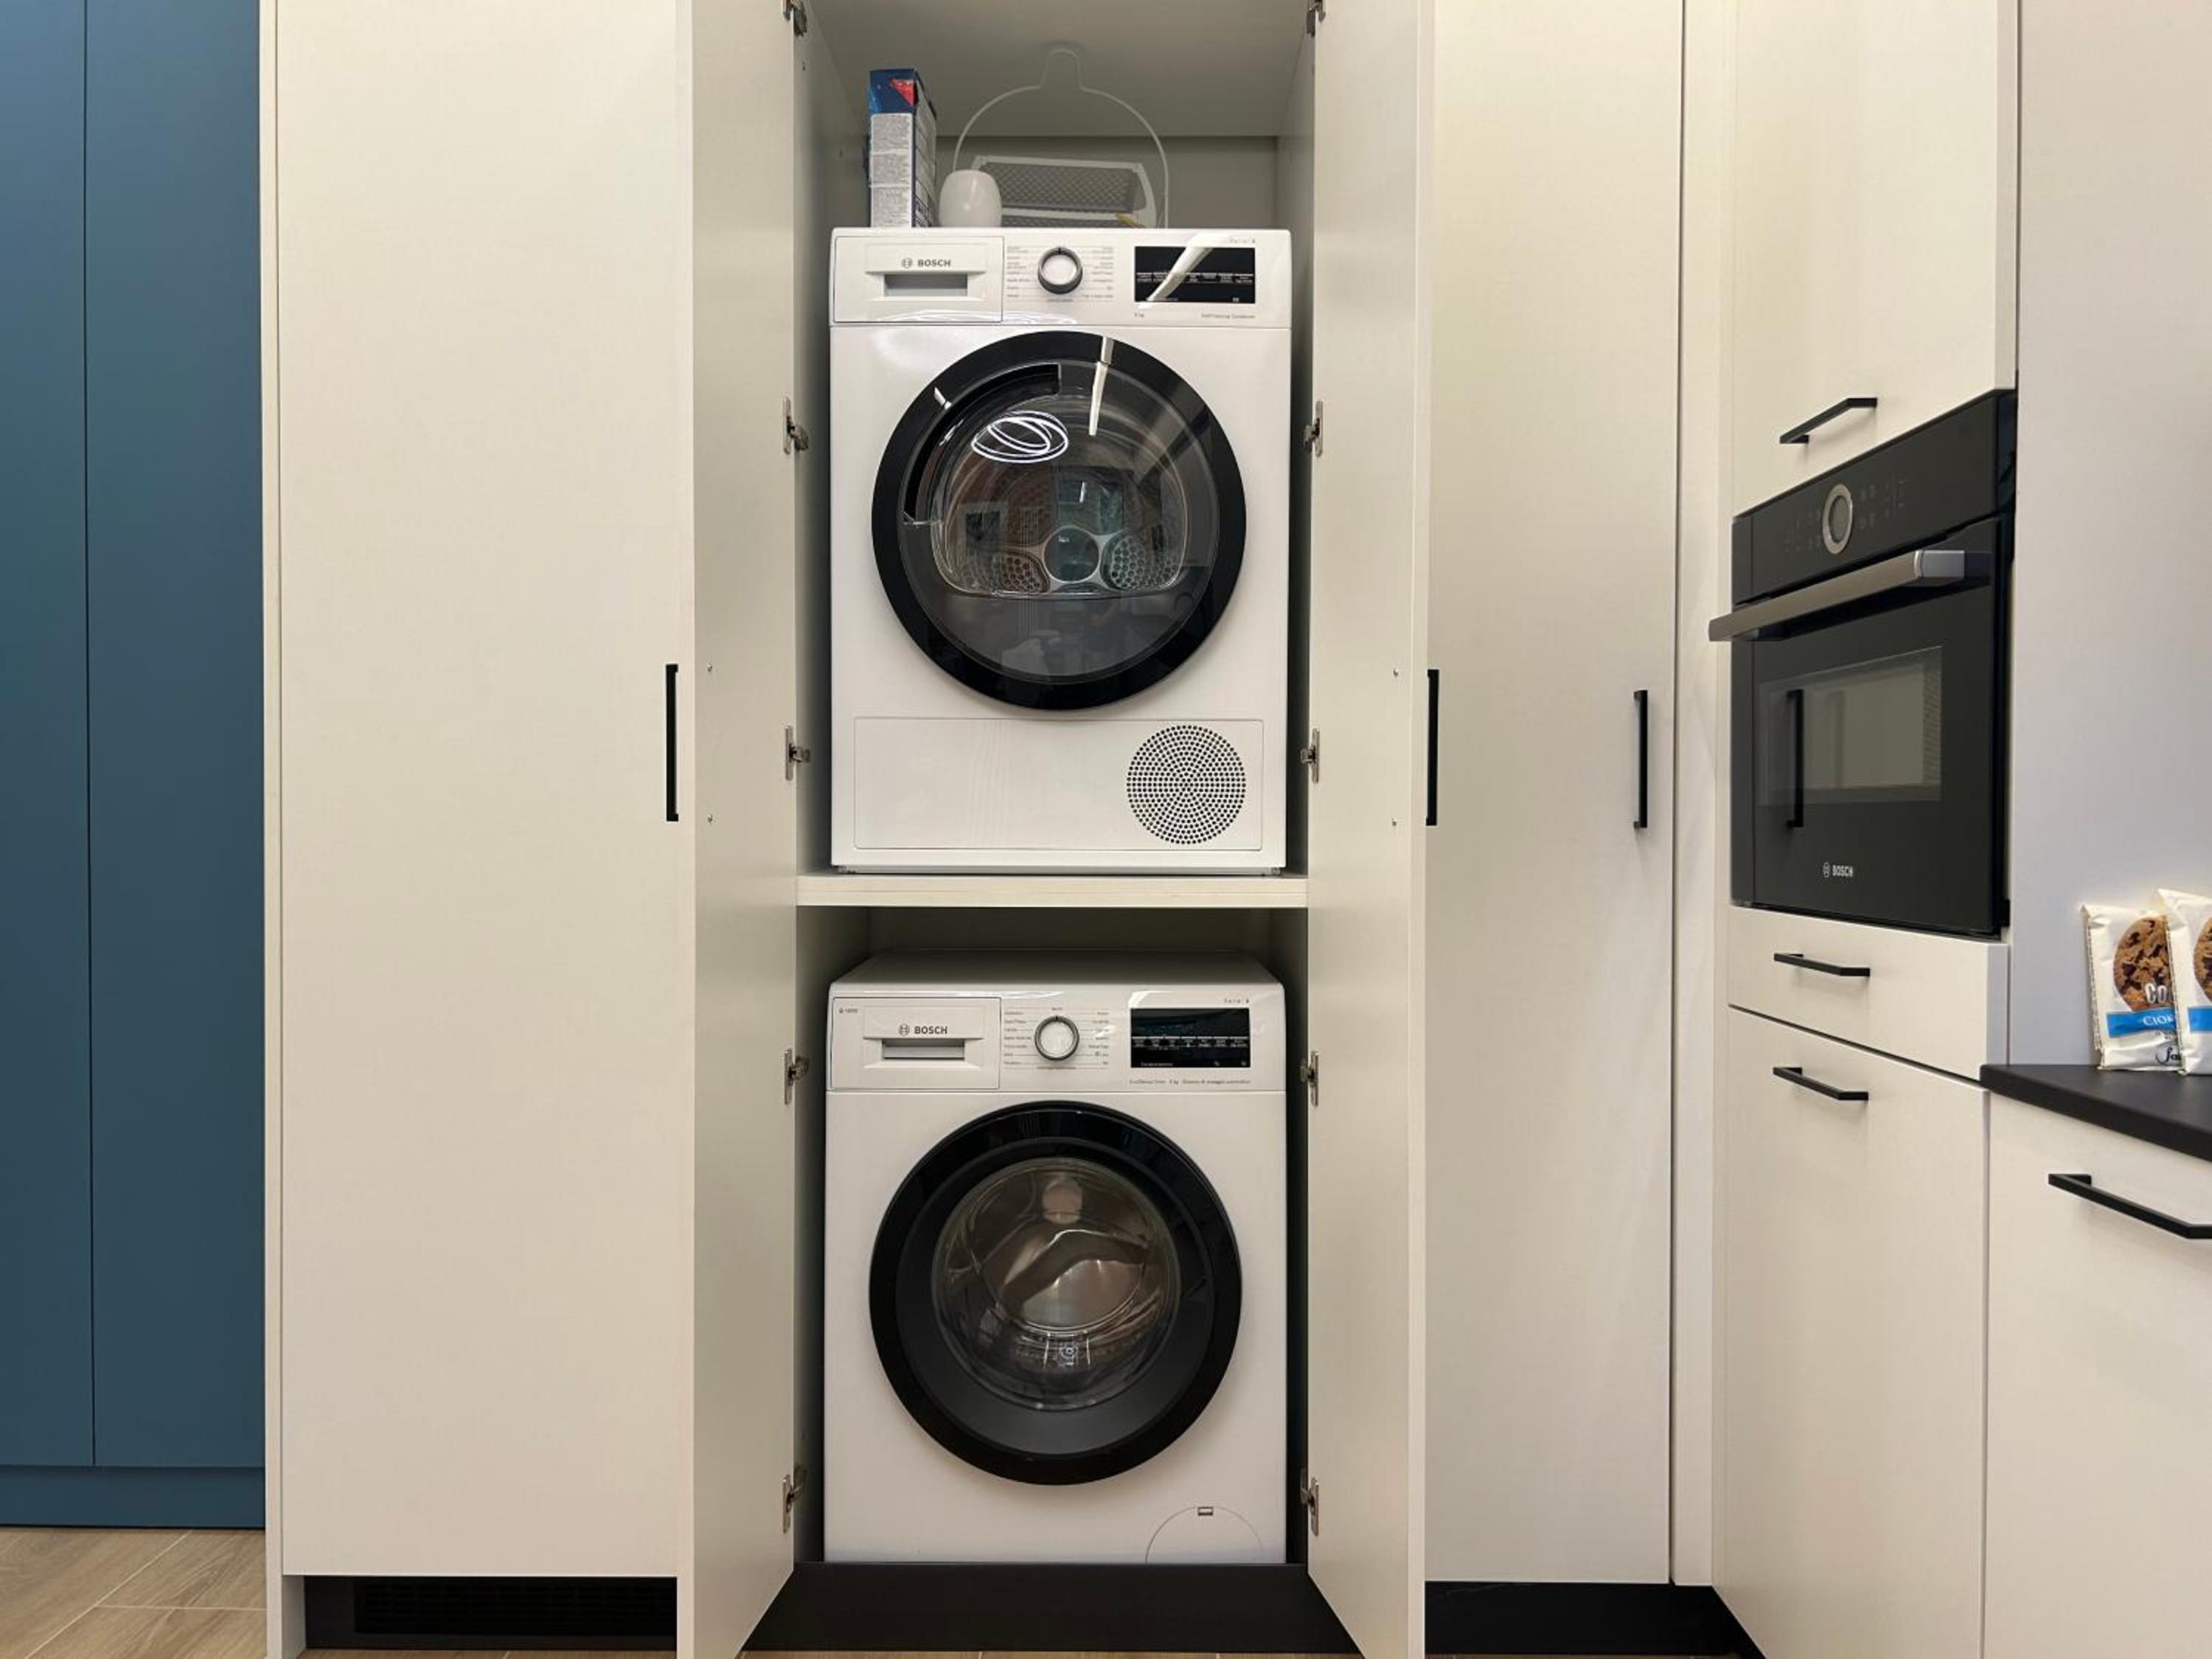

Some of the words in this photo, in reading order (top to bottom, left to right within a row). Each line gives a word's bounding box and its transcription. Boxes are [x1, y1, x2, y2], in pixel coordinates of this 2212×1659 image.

[918, 259, 951, 267] BOSCH
[1832, 865, 1853, 877] BOSCH
[914, 1026, 947, 1034] BOSCH
